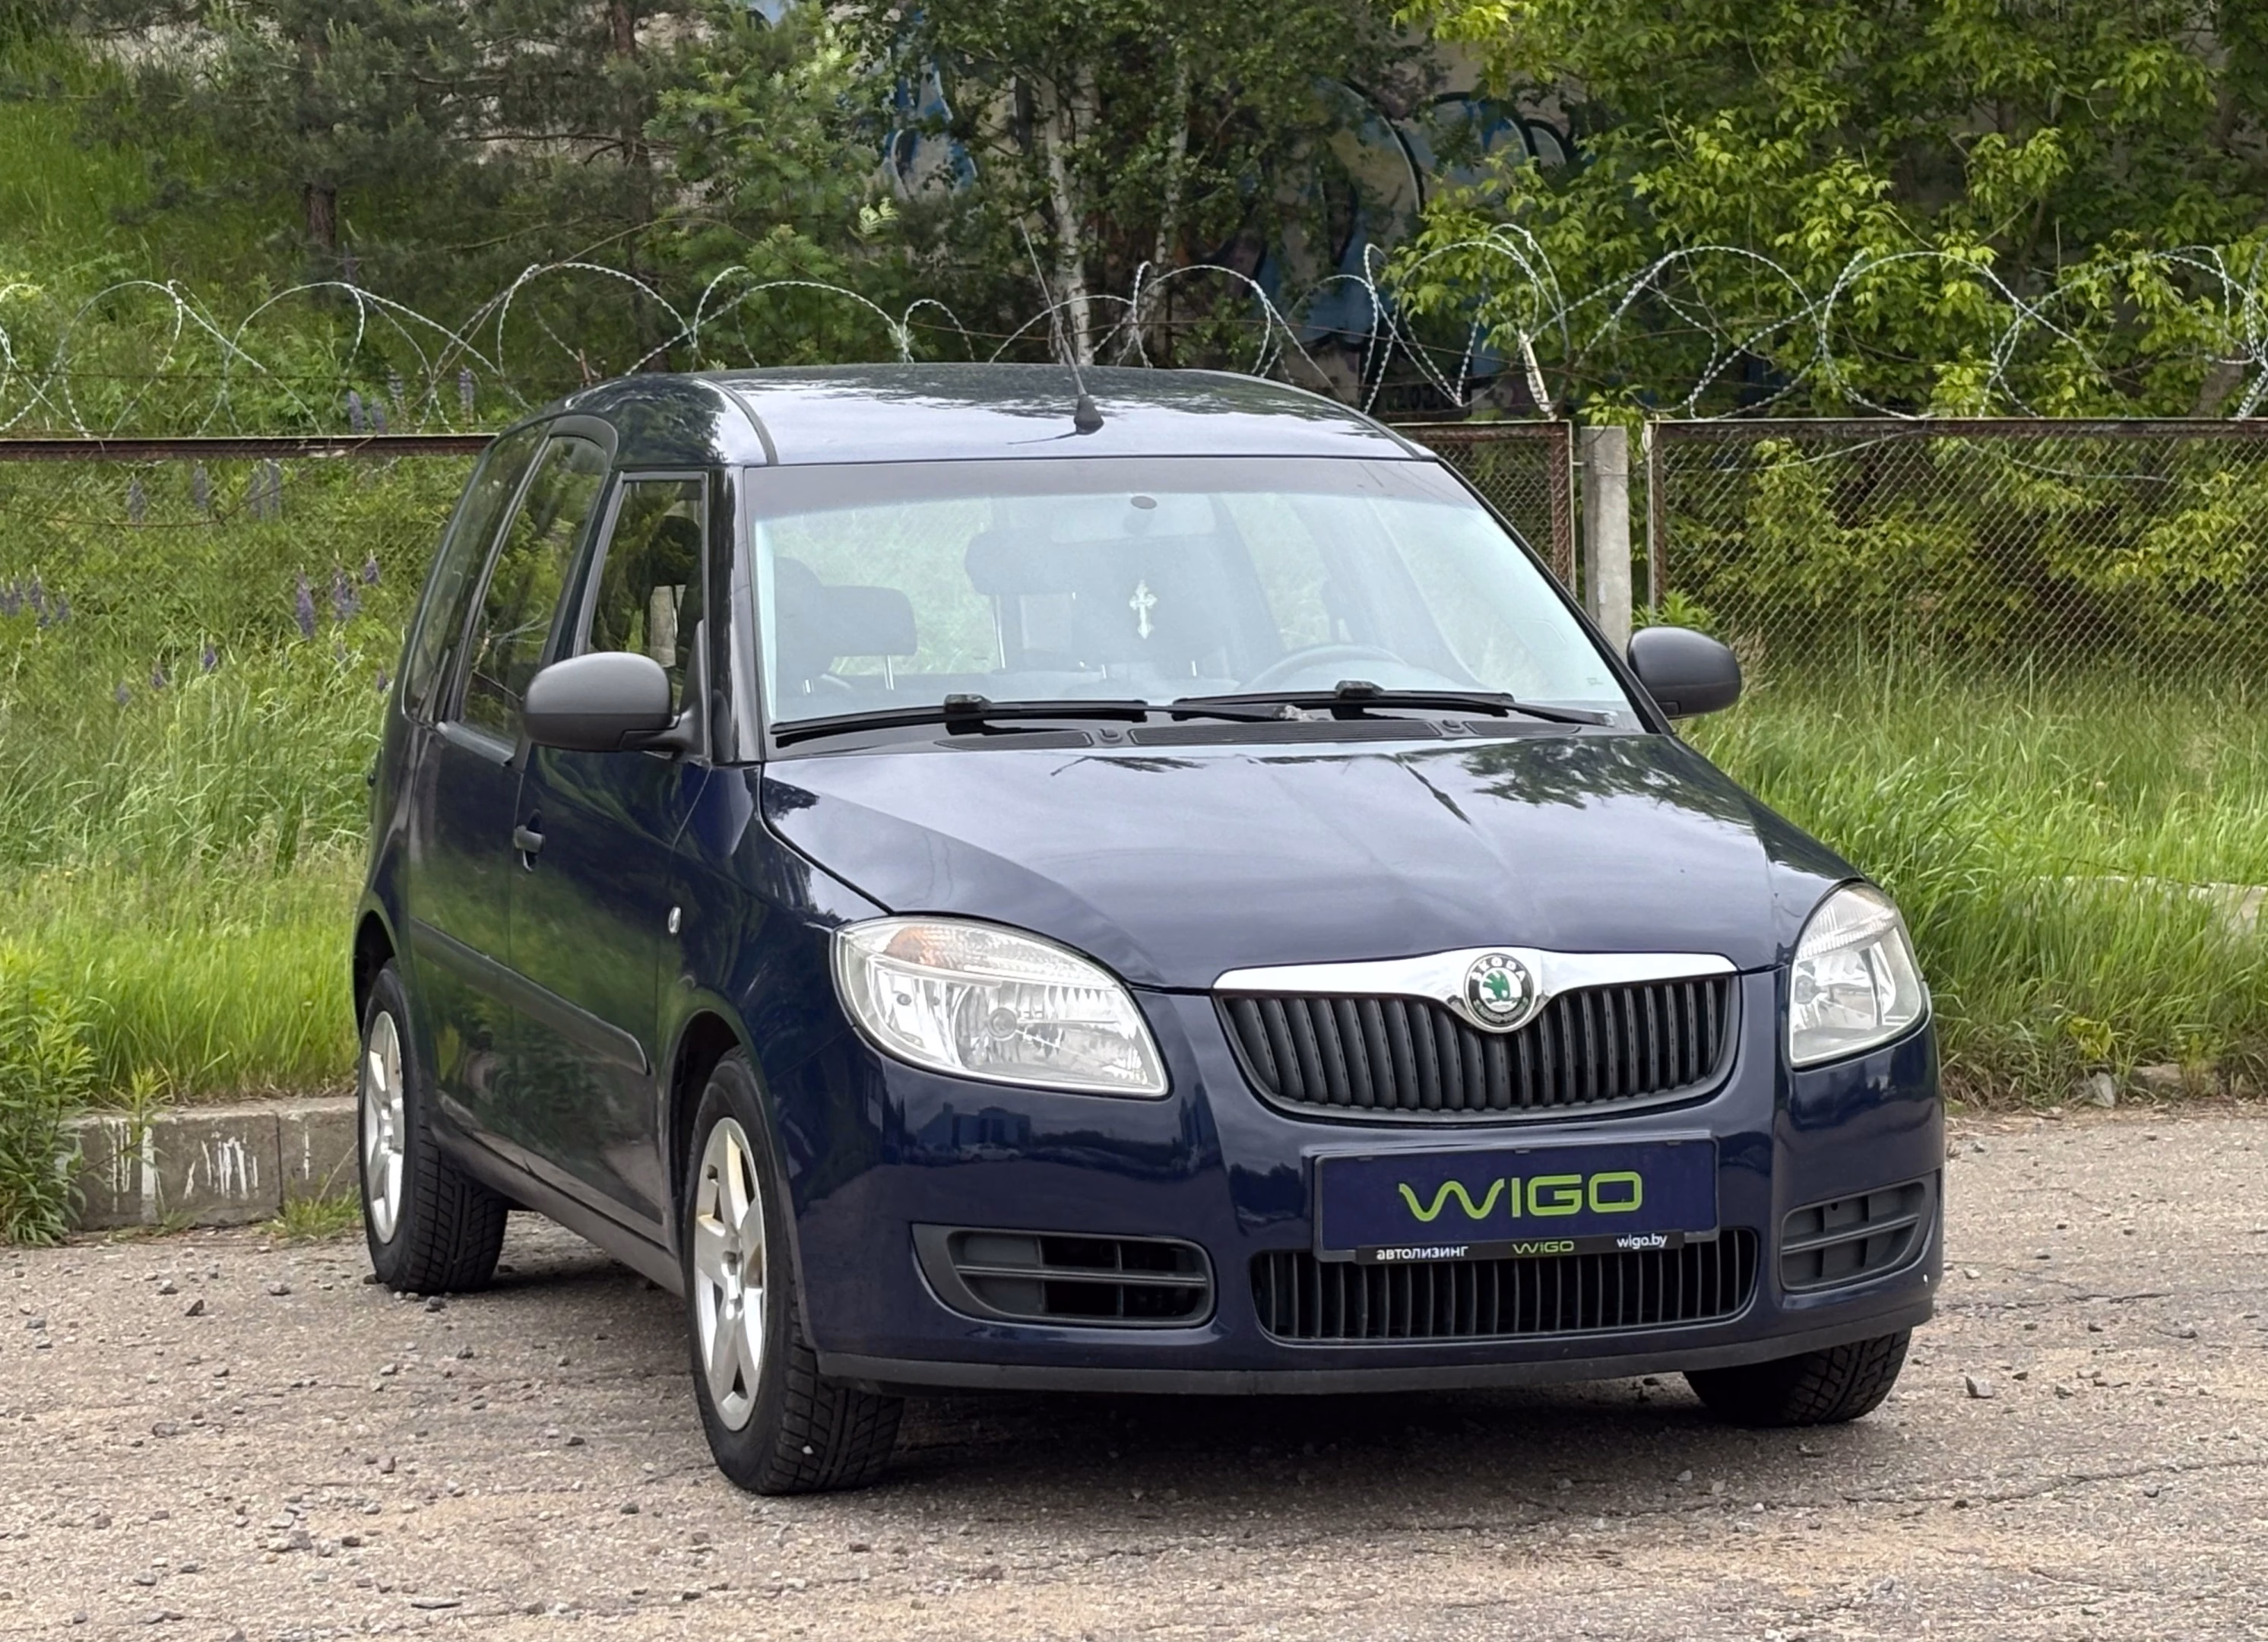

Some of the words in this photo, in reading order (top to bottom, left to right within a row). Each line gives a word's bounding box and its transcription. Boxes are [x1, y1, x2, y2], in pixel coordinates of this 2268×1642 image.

[1398, 1171, 1643, 1222] WIGO
[1376, 1245, 1469, 1261] автолизинг
[1617, 1232, 1668, 1250] wigo.by
